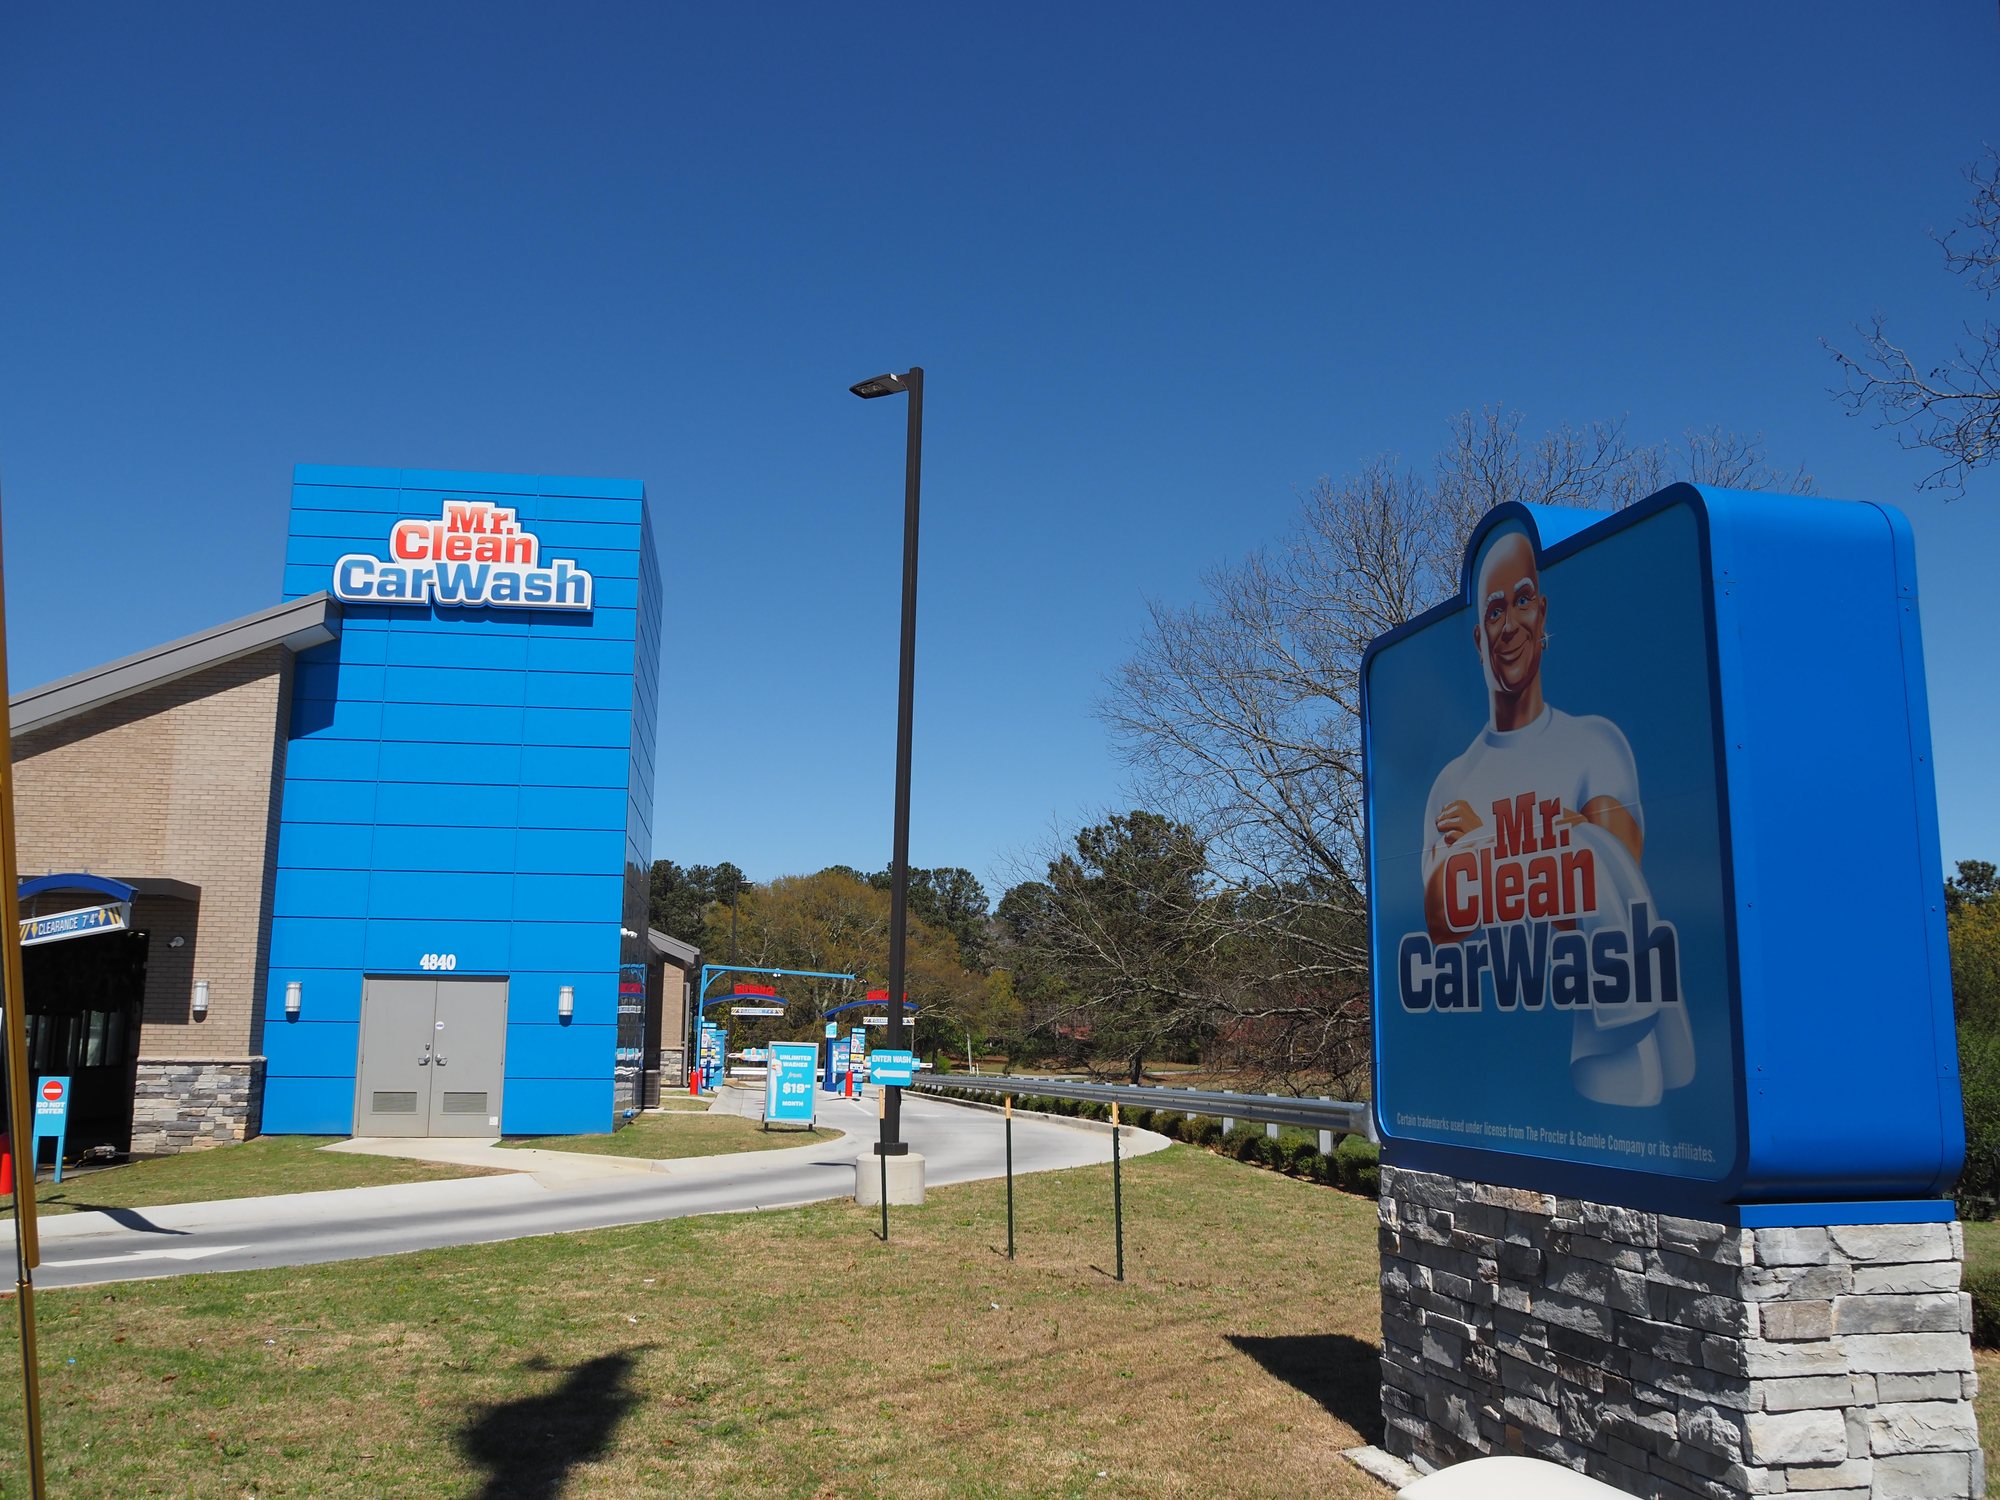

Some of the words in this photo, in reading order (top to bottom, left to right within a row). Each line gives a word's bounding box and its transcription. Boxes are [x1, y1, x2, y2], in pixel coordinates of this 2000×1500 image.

[447, 505, 514, 535] Mr.
[395, 524, 532, 564] Clean
[339, 559, 586, 604] CarWash
[1492, 791, 1571, 860] Mr.
[1445, 848, 1596, 929] Clean
[38, 917, 78, 935] CLEARANCE
[420, 953, 456, 970] 4840
[1400, 902, 1678, 1009] CarWash
[872, 1055, 892, 1063] ENTER
[892, 1055, 911, 1063] WASH
[1396, 1112, 1417, 1126] Certain
[1417, 1115, 1449, 1130] trademarks
[1450, 1119, 1465, 1133] used
[1465, 1121, 1483, 1134] under
[1484, 1122, 1507, 1137] license
[1508, 1124, 1524, 1139] from
[1526, 1126, 1538, 1141] The
[1540, 1127, 1567, 1145] Procter
[1569, 1131, 1575, 1146] &
[1577, 1132, 1605, 1149] Gamble
[1608, 1135, 1645, 1157] Company
[1648, 1142, 1657, 1155] or
[1659, 1140, 1670, 1157] its
[1672, 1142, 1716, 1163] affiliates.
